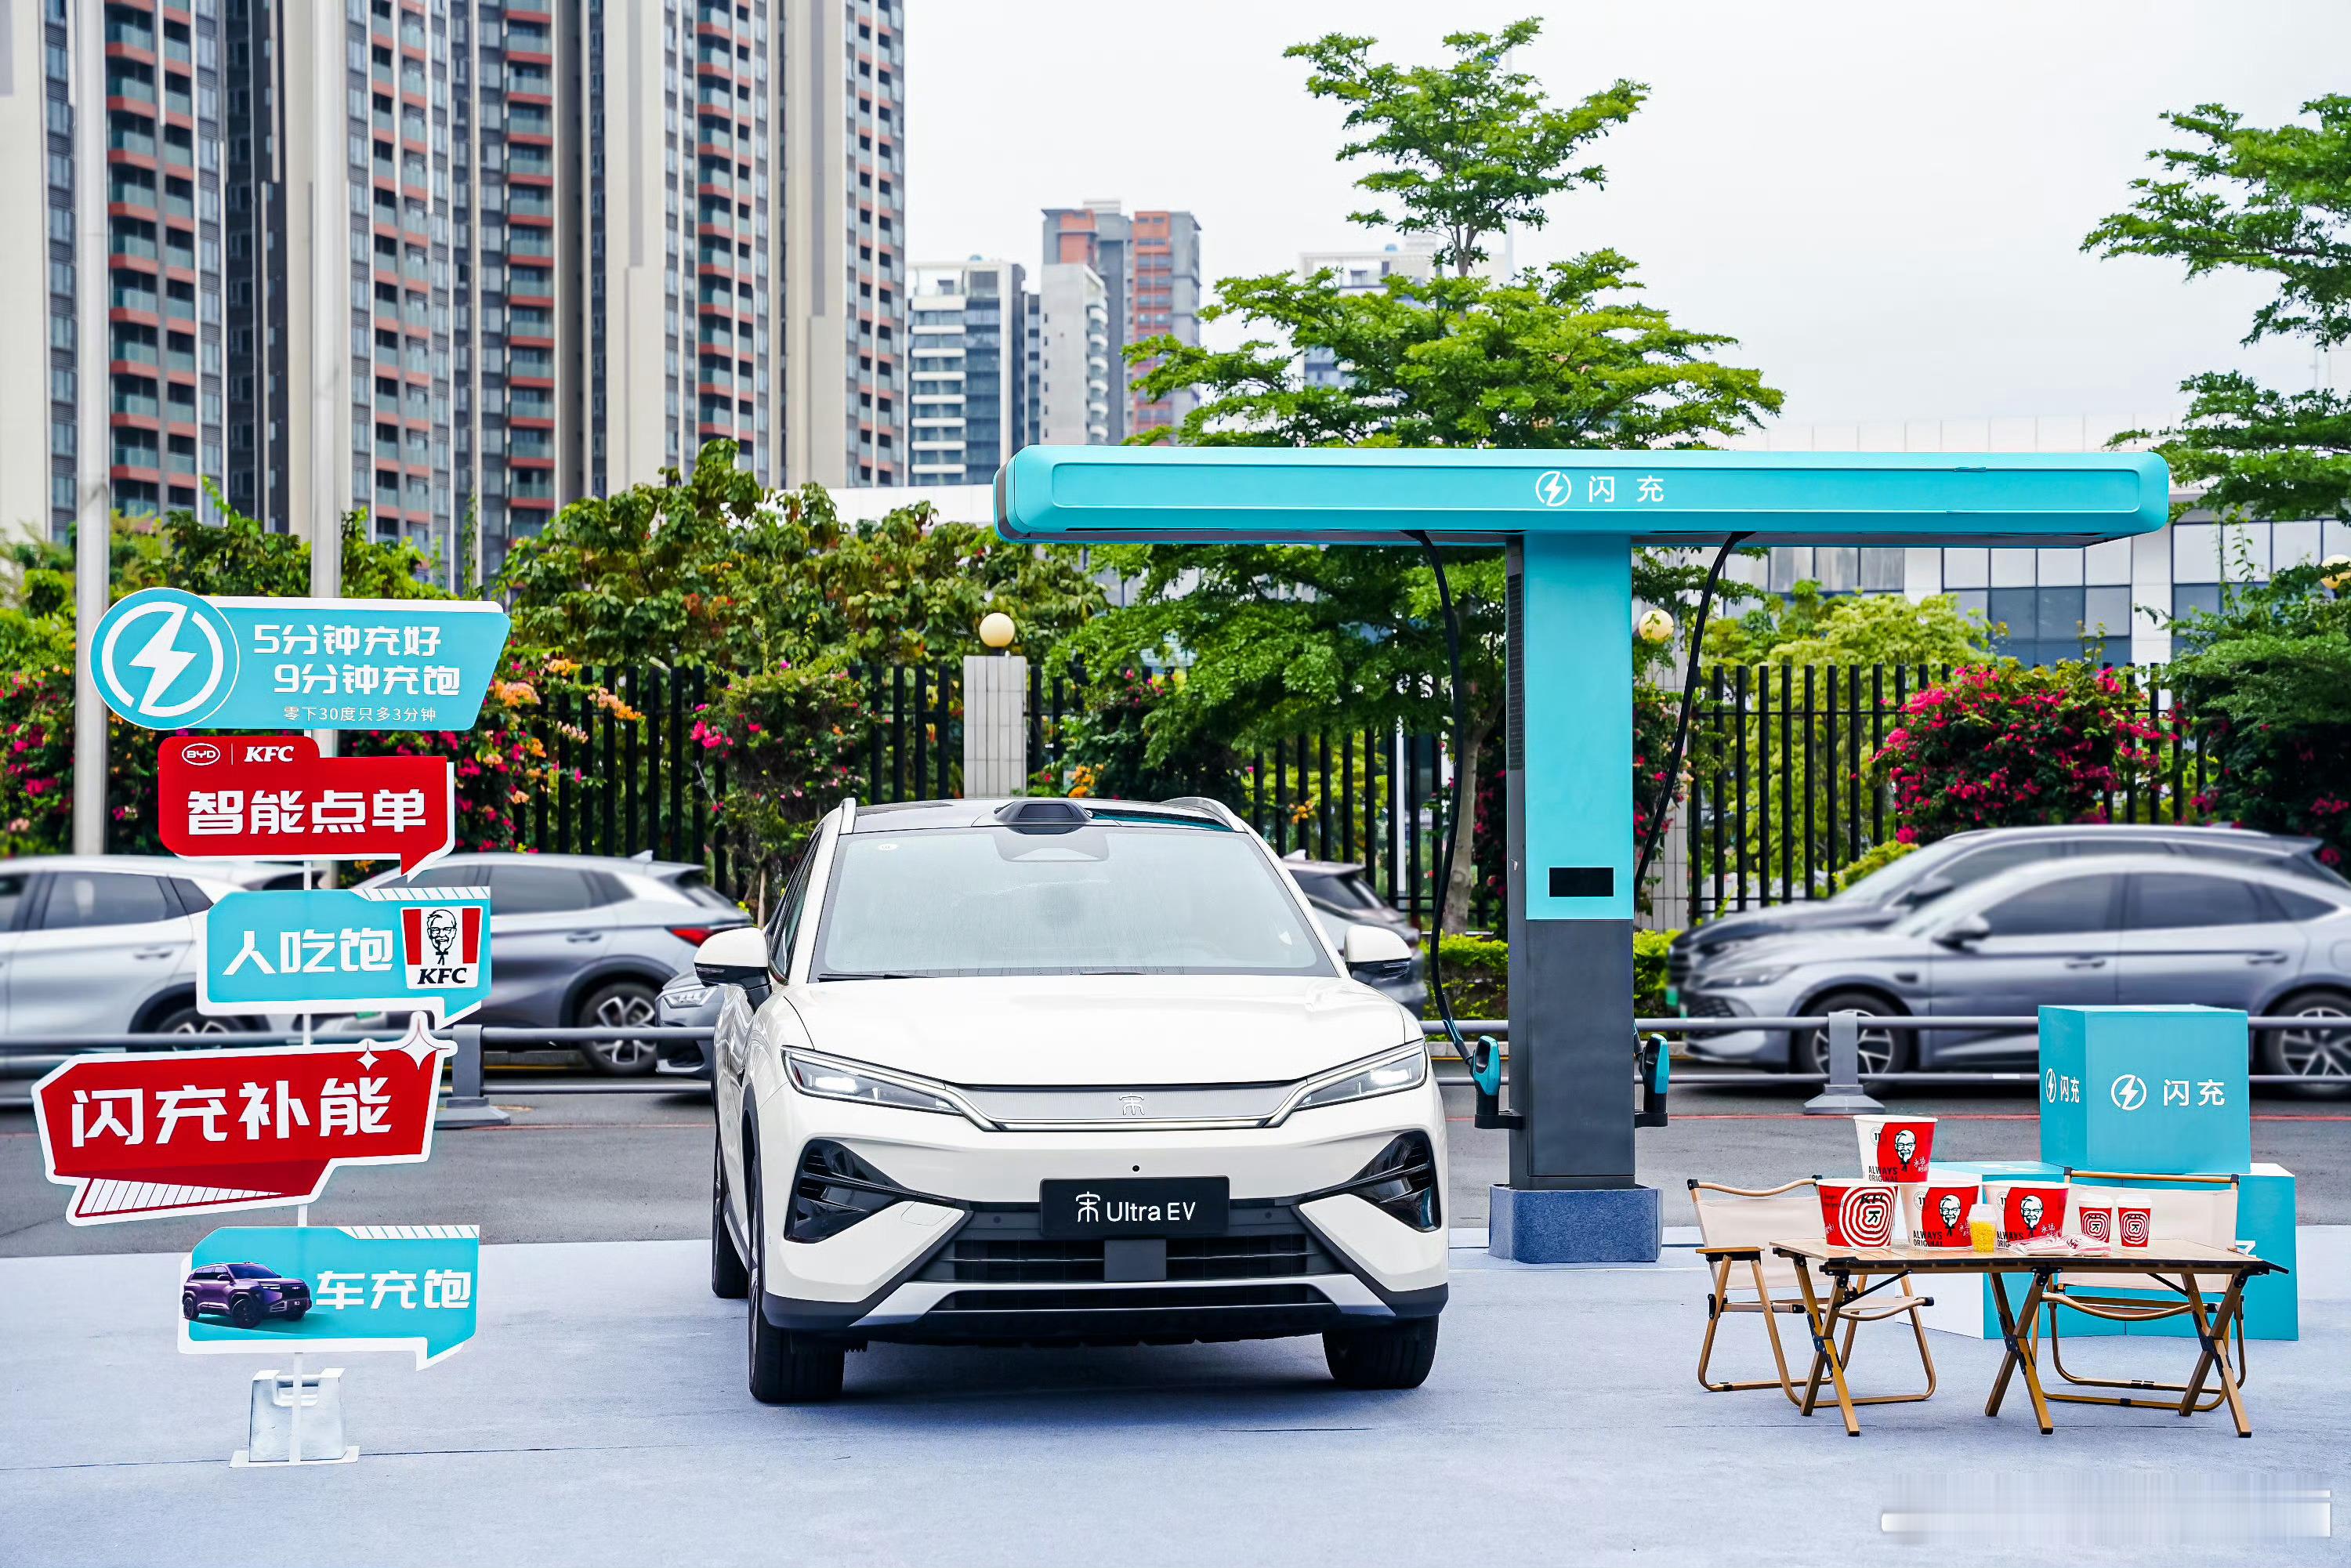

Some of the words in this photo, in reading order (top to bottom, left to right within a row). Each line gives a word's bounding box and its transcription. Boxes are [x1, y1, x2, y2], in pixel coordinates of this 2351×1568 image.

[1588, 475, 1665, 502] 闪充
[254, 625, 441, 656] 5分钟充好
[273, 664, 460, 695] 9分钟充饱
[283, 706, 437, 722] 零下30度只多3分钟
[187, 750, 216, 759] BYD
[244, 745, 295, 762] KFC
[187, 788, 426, 835] 智能点单
[223, 927, 393, 976] 人吃饱
[417, 967, 467, 985] KFC
[2059, 1074, 2081, 1103] 闪充
[2163, 1078, 2226, 1106] 闪充
[71, 1077, 393, 1148] 闪充补能
[1868, 1165, 1899, 1175] ALWAYS
[1107, 1201, 1161, 1222] Ultra
[1167, 1201, 1196, 1221] EV
[1913, 1229, 1943, 1240] ALWAYS
[1996, 1230, 2024, 1240] ALWAYS
[316, 1269, 471, 1310] 车充饱
